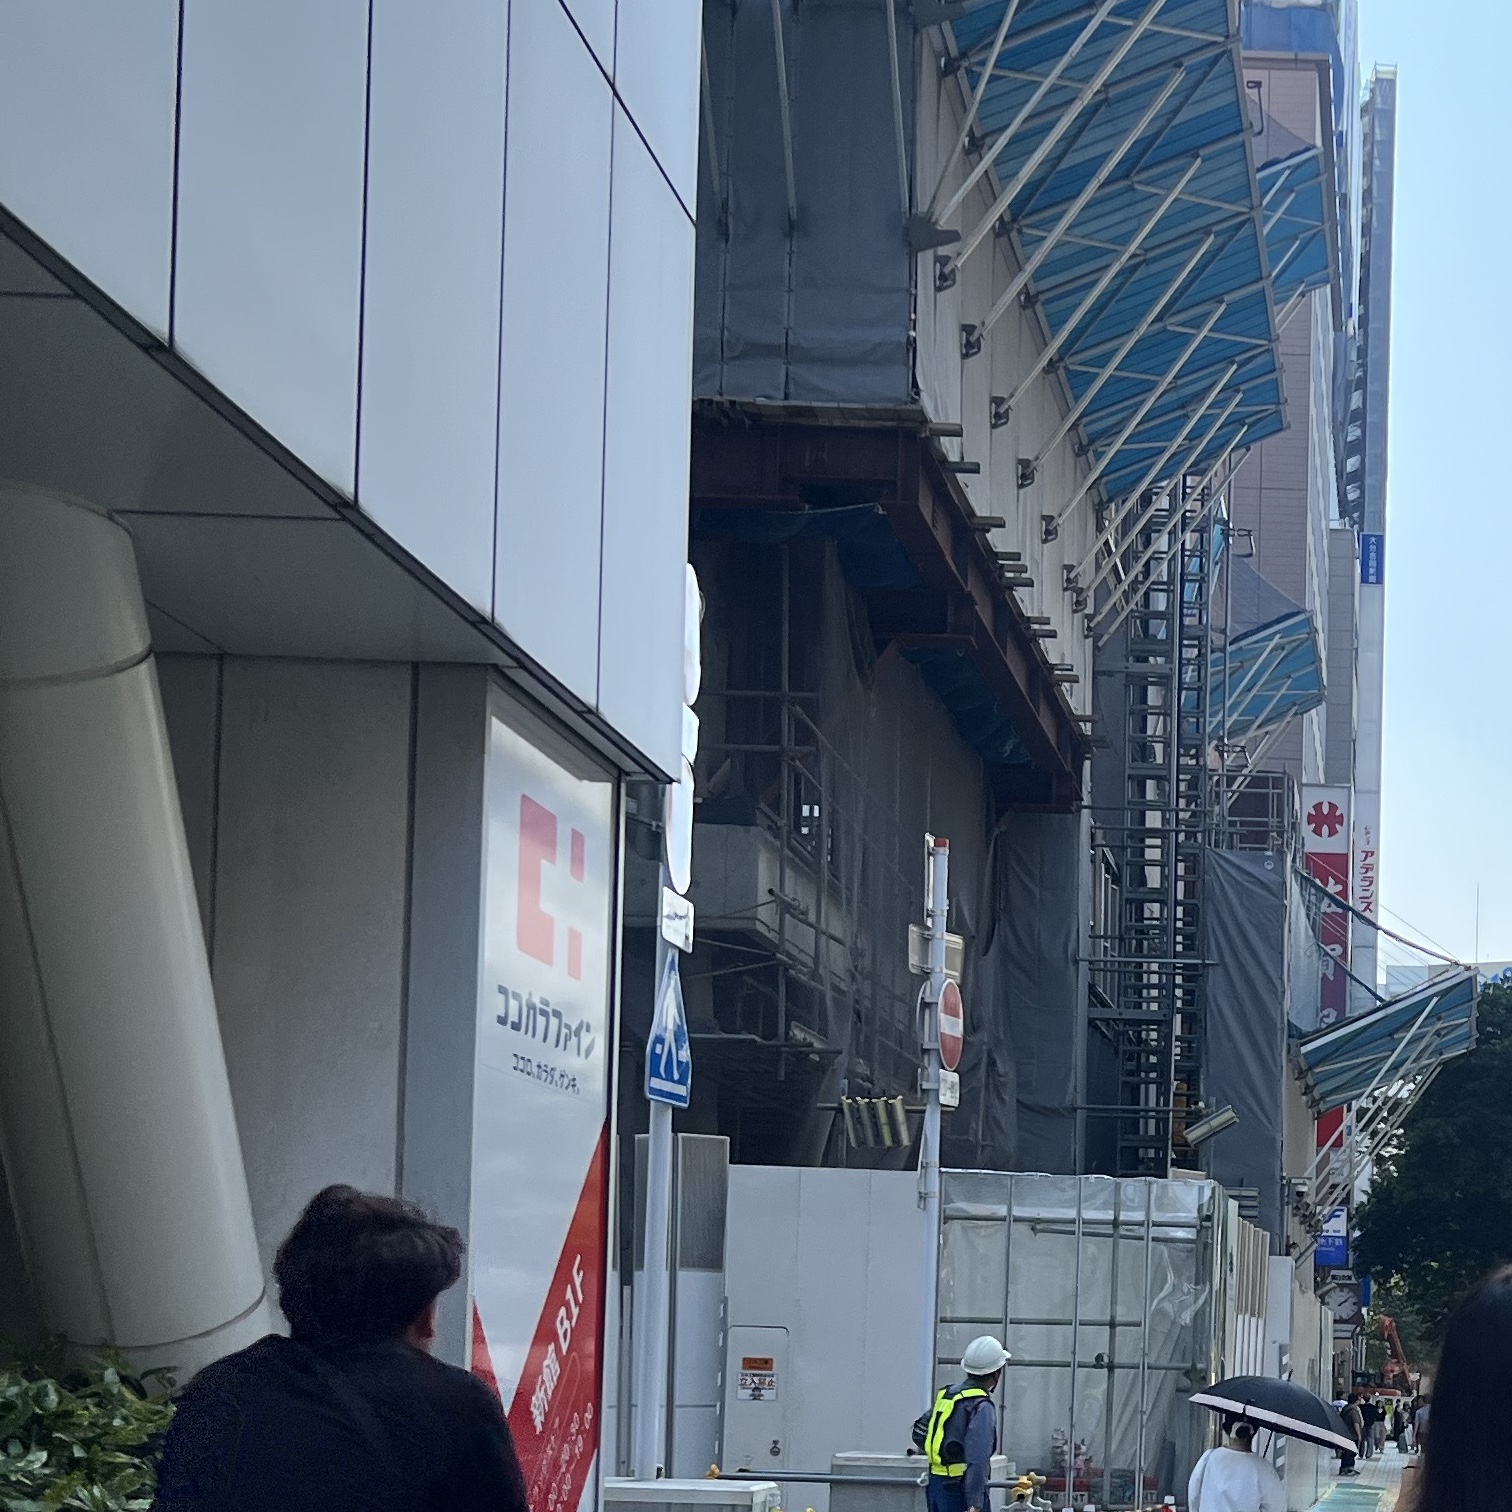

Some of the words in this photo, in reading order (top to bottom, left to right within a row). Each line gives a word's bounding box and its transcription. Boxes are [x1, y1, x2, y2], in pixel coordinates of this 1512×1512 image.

[1359, 850, 1375, 914] アデランス
[496, 983, 596, 1061] ココカラファイン
